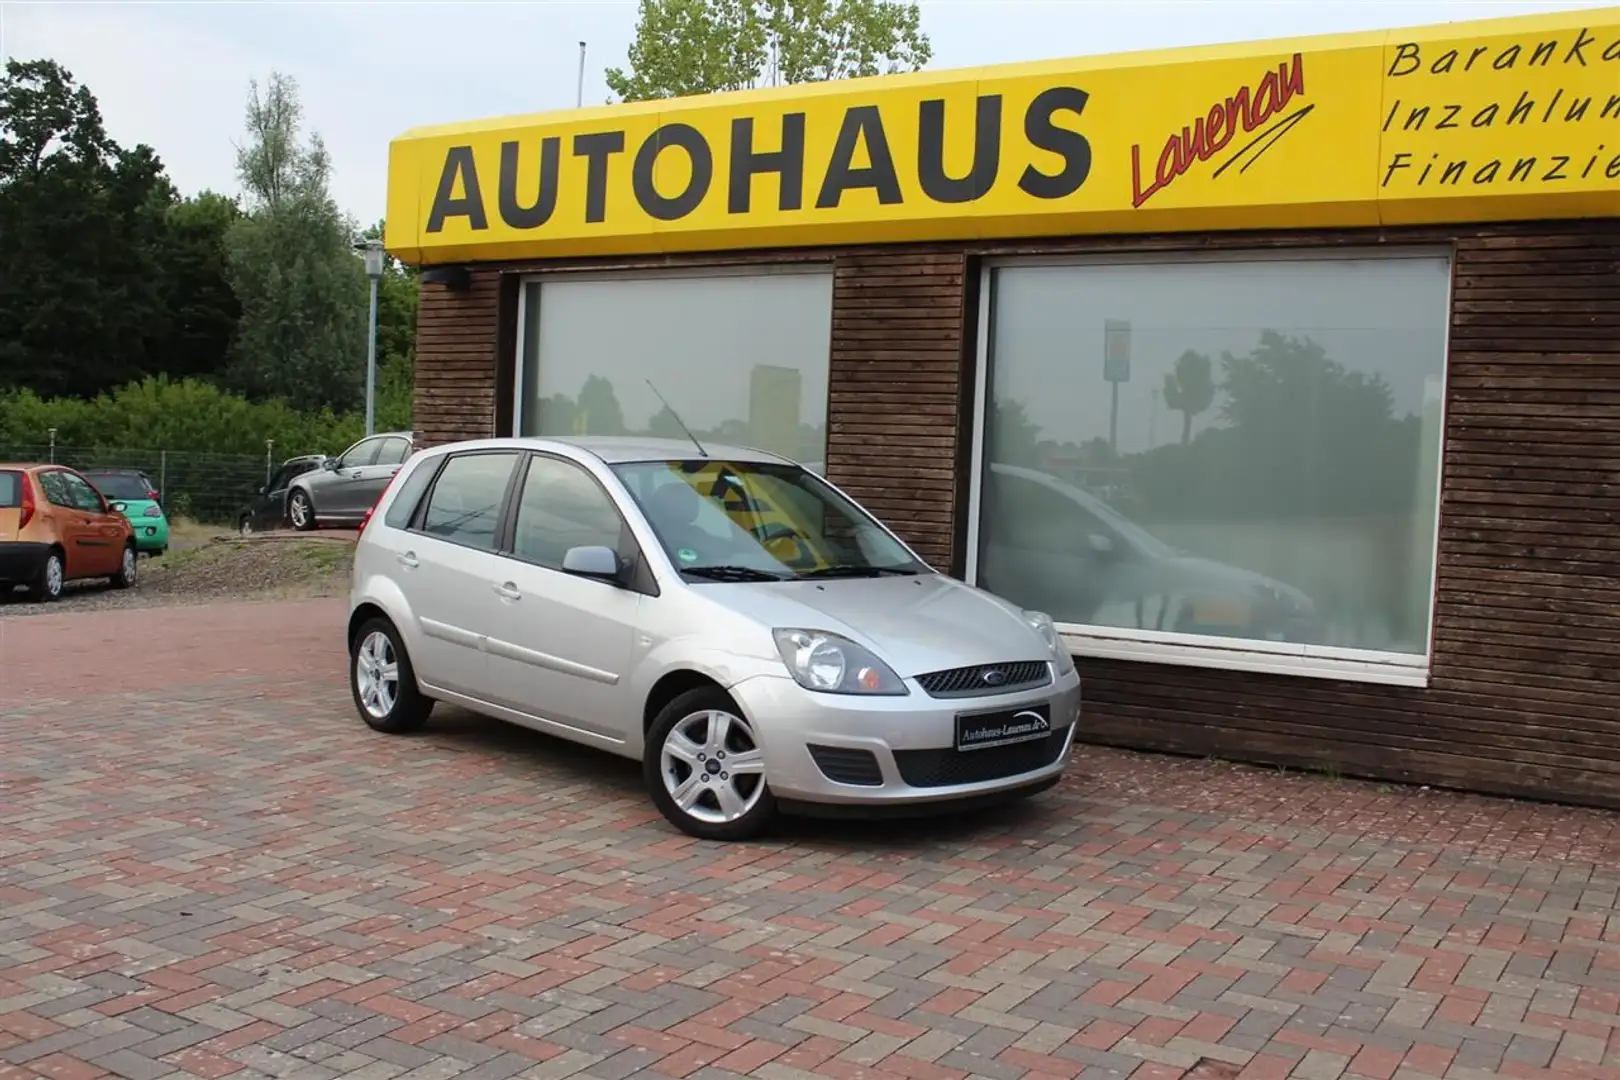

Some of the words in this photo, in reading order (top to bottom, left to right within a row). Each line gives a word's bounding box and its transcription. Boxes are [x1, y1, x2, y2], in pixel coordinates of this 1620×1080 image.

[1387, 27, 1620, 77] Baranka
[1382, 88, 1620, 132] Inzahlun
[426, 86, 1092, 234] AUTOHAUS
[1132, 53, 1304, 209] Lauenau
[1381, 144, 1620, 188] Finanzie
